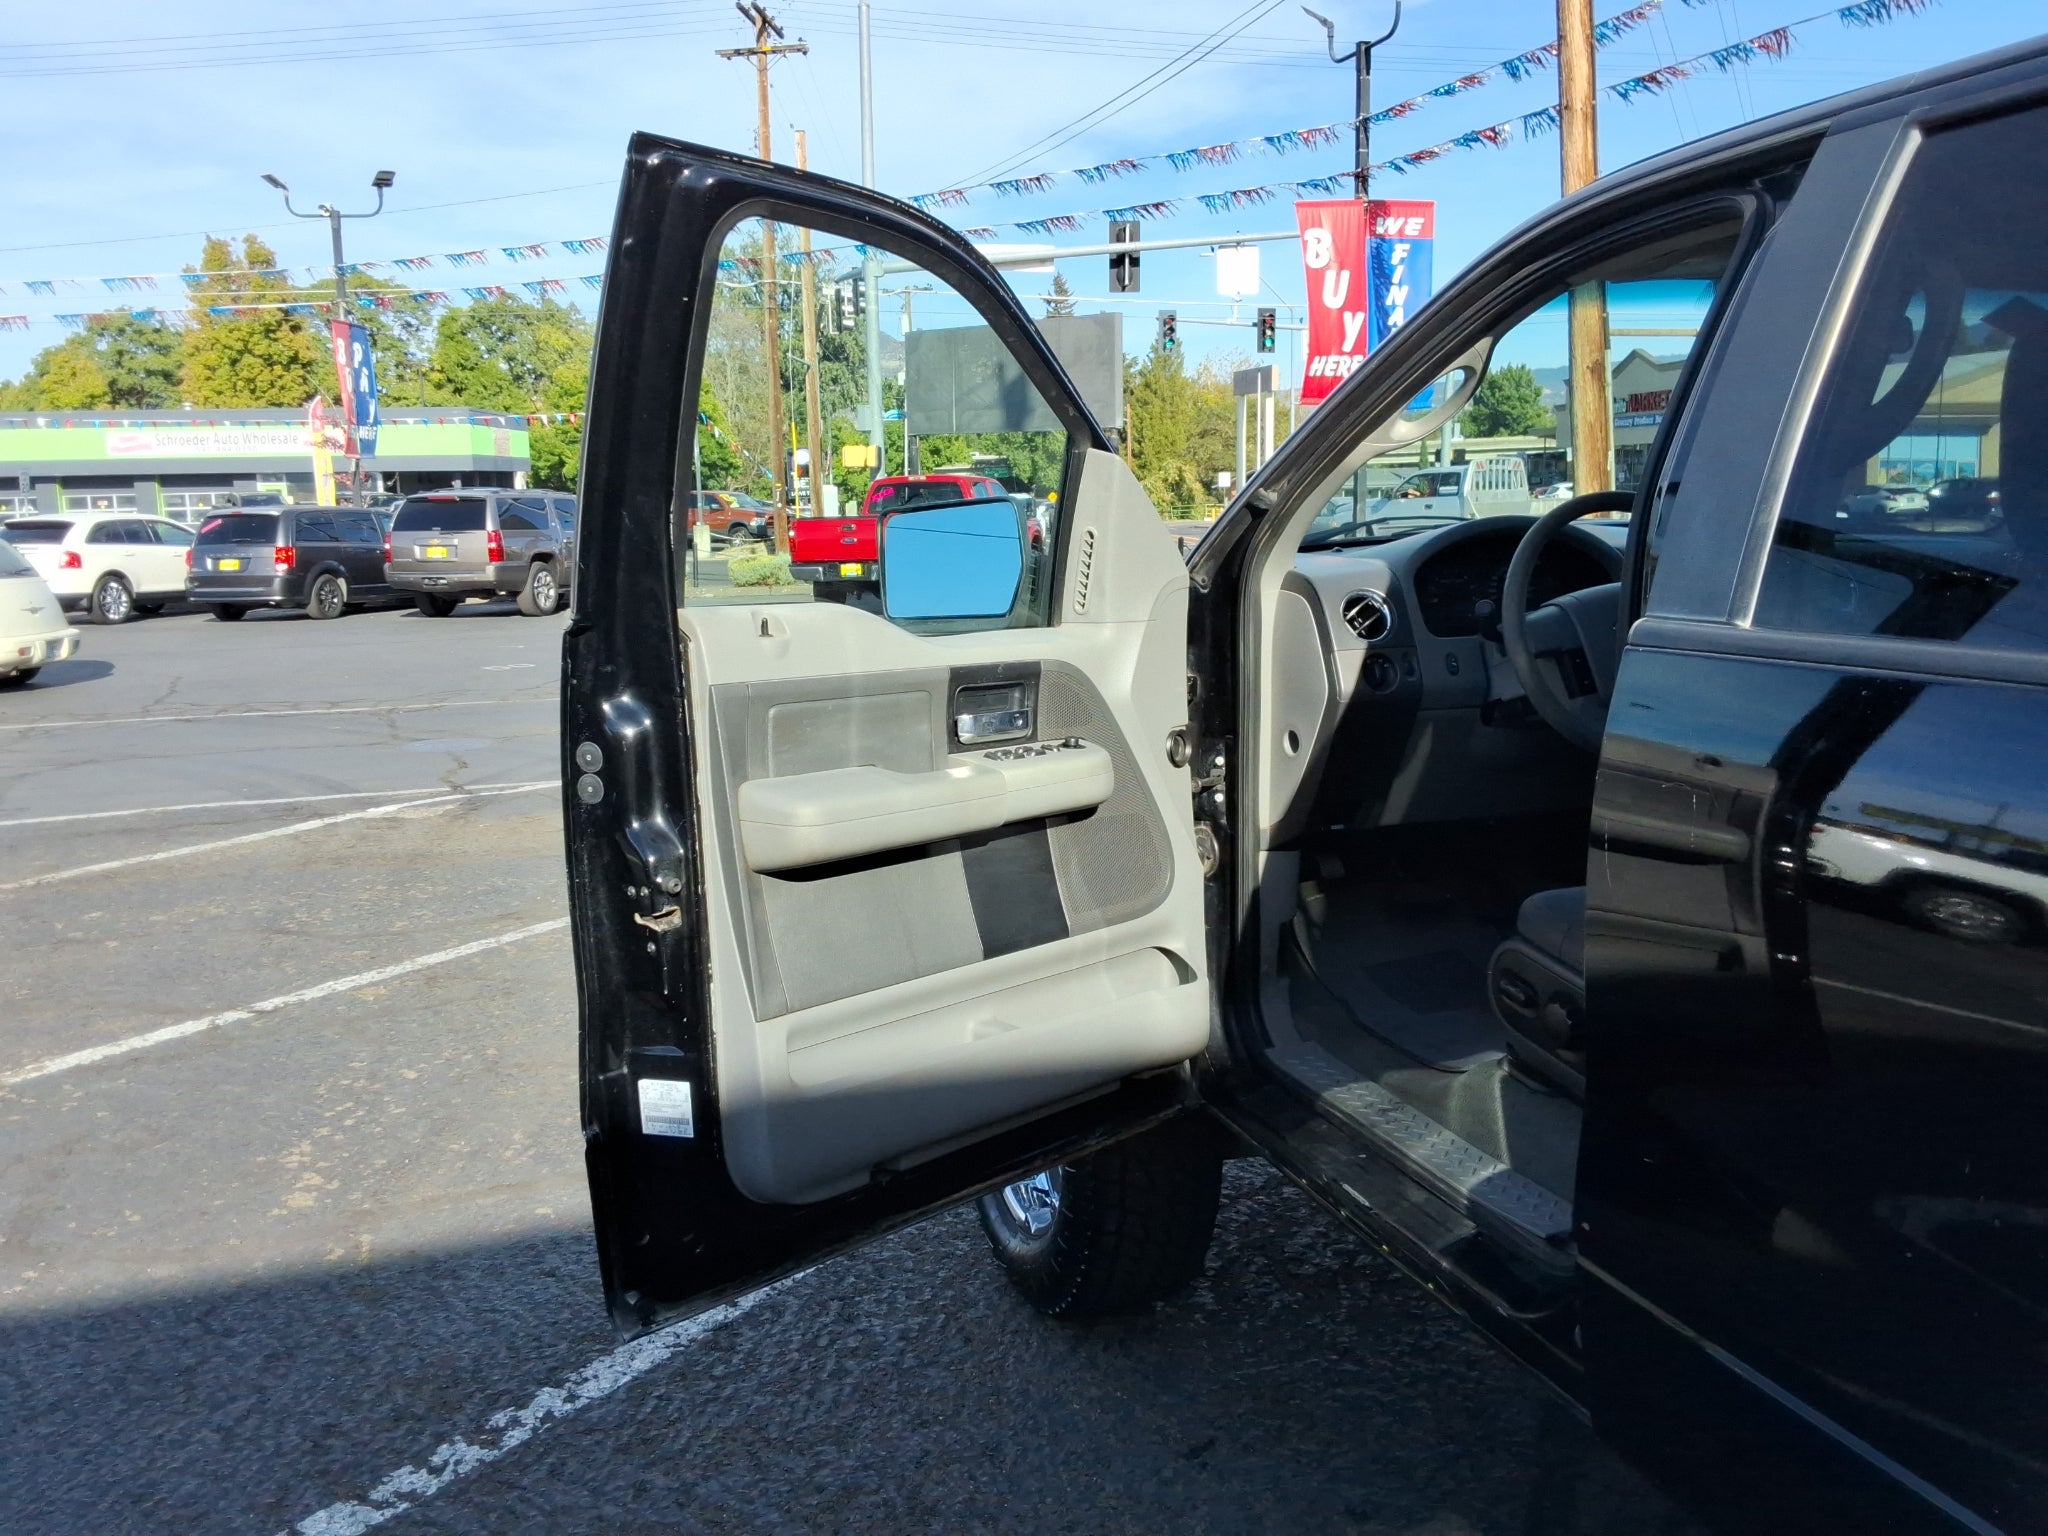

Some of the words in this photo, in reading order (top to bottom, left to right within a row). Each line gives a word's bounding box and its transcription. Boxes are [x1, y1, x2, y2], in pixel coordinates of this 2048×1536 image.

[1376, 217, 1425, 236] WE
[1304, 227, 1366, 353] BUY
[1385, 243, 1411, 331] FINA
[155, 433, 210, 447] Schroeder
[214, 432, 239, 446] Auto
[242, 431, 299, 446] Wholesale
